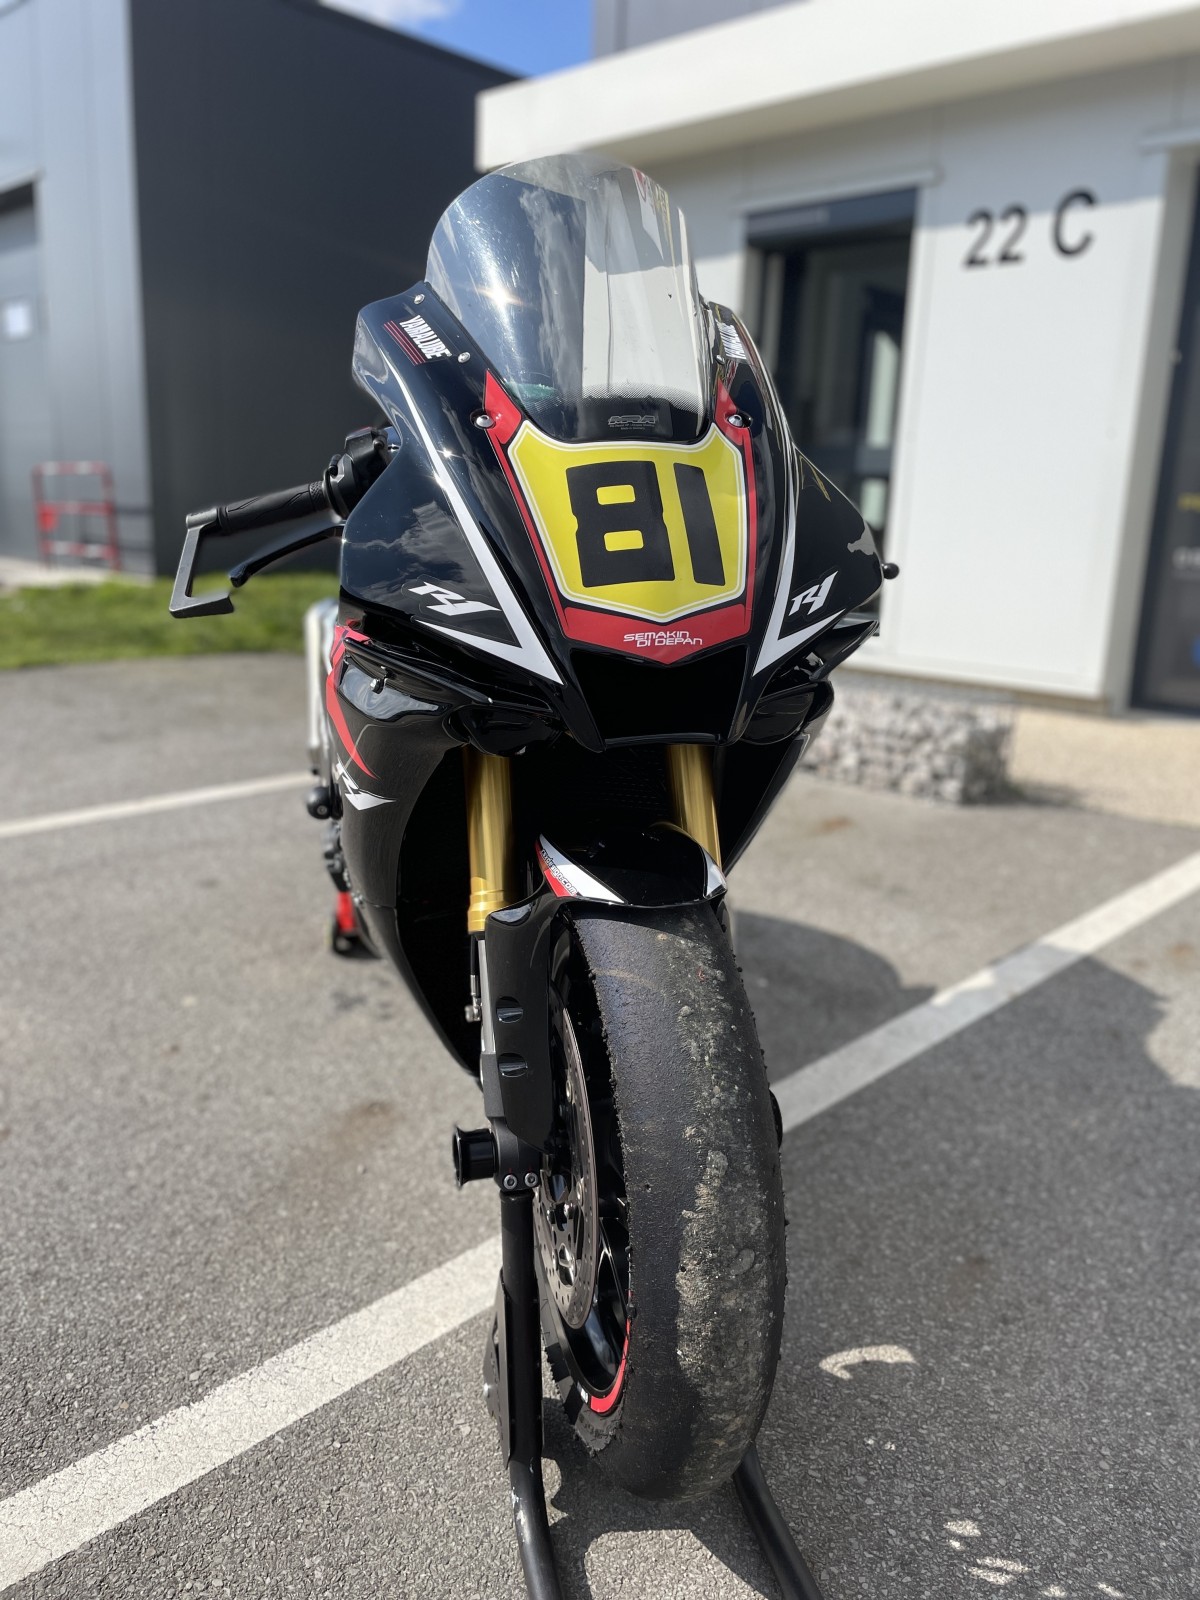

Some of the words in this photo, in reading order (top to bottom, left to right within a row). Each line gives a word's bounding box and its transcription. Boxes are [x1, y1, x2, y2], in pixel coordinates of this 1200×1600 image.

[963, 204, 1027, 268] 22
[1052, 187, 1095, 258] C
[399, 314, 451, 359] YAMALUBE
[566, 460, 726, 588] 81
[623, 631, 690, 642] SEMAKIN
[636, 639, 651, 648] DI
[654, 637, 703, 646] DEPAN
